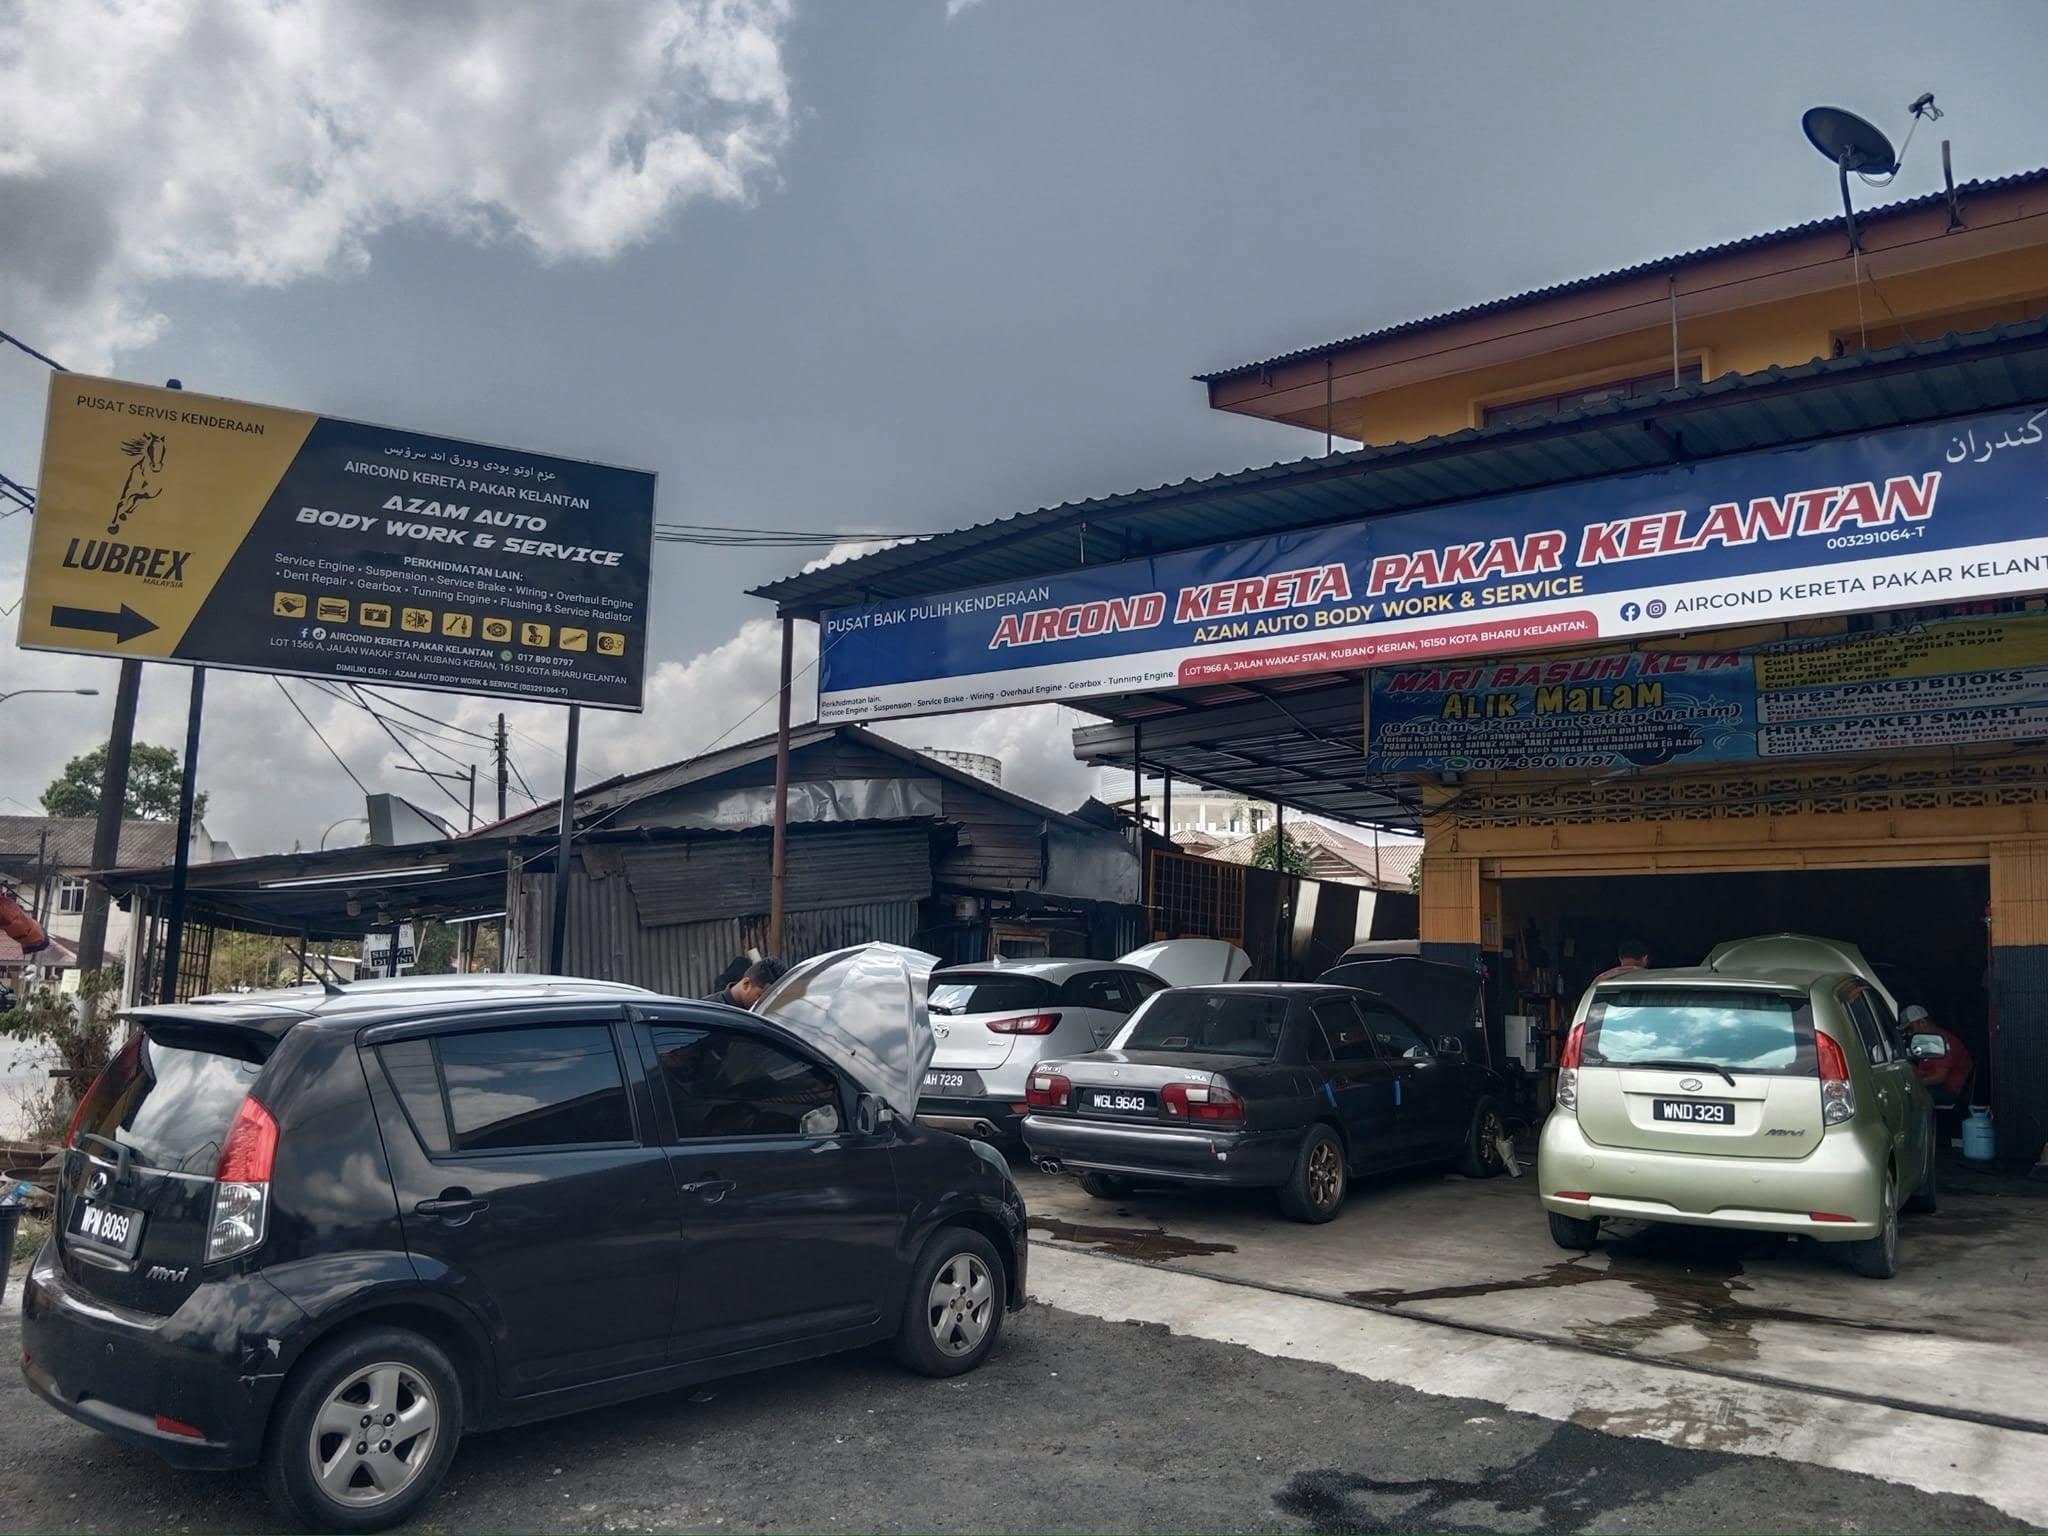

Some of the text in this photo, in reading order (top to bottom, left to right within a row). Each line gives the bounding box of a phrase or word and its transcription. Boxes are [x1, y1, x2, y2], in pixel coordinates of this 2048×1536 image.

[77, 395, 265, 436] PUSAT SERVIS KENDERAAN
[344, 460, 590, 510] AIRCOND KERETA PAKAR KELANTAN
[382, 495, 547, 532] AZAM AUTO
[296, 506, 625, 566] BODY WORK & SERVICE
[1826, 526, 1926, 550] 003291064-T
[62, 537, 192, 581] LUBREX
[404, 556, 524, 582] PERKHIDMATAN LAIN:
[988, 470, 1942, 650] AIRCOND KERETA PAKAR KELANTAN
[143, 577, 184, 588] MALAYSIA
[275, 553, 634, 611] Service Engine Suspension Service Brake Wiring Overhaul Engine
[284, 569, 632, 623] Dent Repair Gearbox Tunning Engine Flushing & Service Radiator
[1674, 588, 1773, 614] AIRCOND
[1780, 577, 1866, 600] KERETA
[1872, 567, 1953, 590] PAKAR
[828, 586, 1050, 634] PUSAT BAIK PULIH KENDERAAN
[1193, 575, 1585, 643] AZAM AUTO BODY WORK & SERVICE
[270, 637, 290, 647] LOT
[316, 642, 325, 652] A,
[327, 644, 358, 655] JALAN
[360, 648, 394, 658] WAKAF
[394, 651, 422, 663] STAN,
[424, 654, 462, 666] KUBANG
[463, 660, 497, 672] KERIAN,
[500, 664, 526, 674] 16150
[527, 667, 551, 676] KOTA
[552, 669, 582, 680] BHARU
[583, 672, 628, 684] KELANTAN
[330, 632, 494, 658] AIRCOND KERETA PAKAR KELANTAN
[518, 653, 574, 667] 017 890 0797
[1184, 620, 1588, 676] LOT 1966 A, JALAN WAKAF STAN, KUBANG KERIAN, 16150 KOTA BHARU KELANTAN.
[336, 664, 367, 674] DIMILIKI
[394, 670, 417, 679] AZAM
[418, 672, 439, 681] AUTO
[440, 674, 459, 684] BODY
[460, 676, 482, 686] WORK
[489, 680, 519, 690] SERVICE
[1386, 668, 1484, 694] MARI
[1489, 653, 1633, 688] BASUH
[1764, 672, 2024, 704] Harga PAKEJ BIJOKS
[822, 670, 1176, 718] Service Engine Suspension Service Brake Wiring Overhaul Engine Gearbox Tunning Engine.
[822, 696, 867, 708] Perkhidmatan
[1765, 724, 1837, 736] Harga
[1844, 715, 1922, 730] PAKEJ
[1930, 706, 2025, 724] SMART
[1565, 754, 1617, 768] 0797
[940, 1074, 963, 1086] 7229
[1664, 1103, 1724, 1122] WND 329
[102, 1212, 130, 1243] 8069
